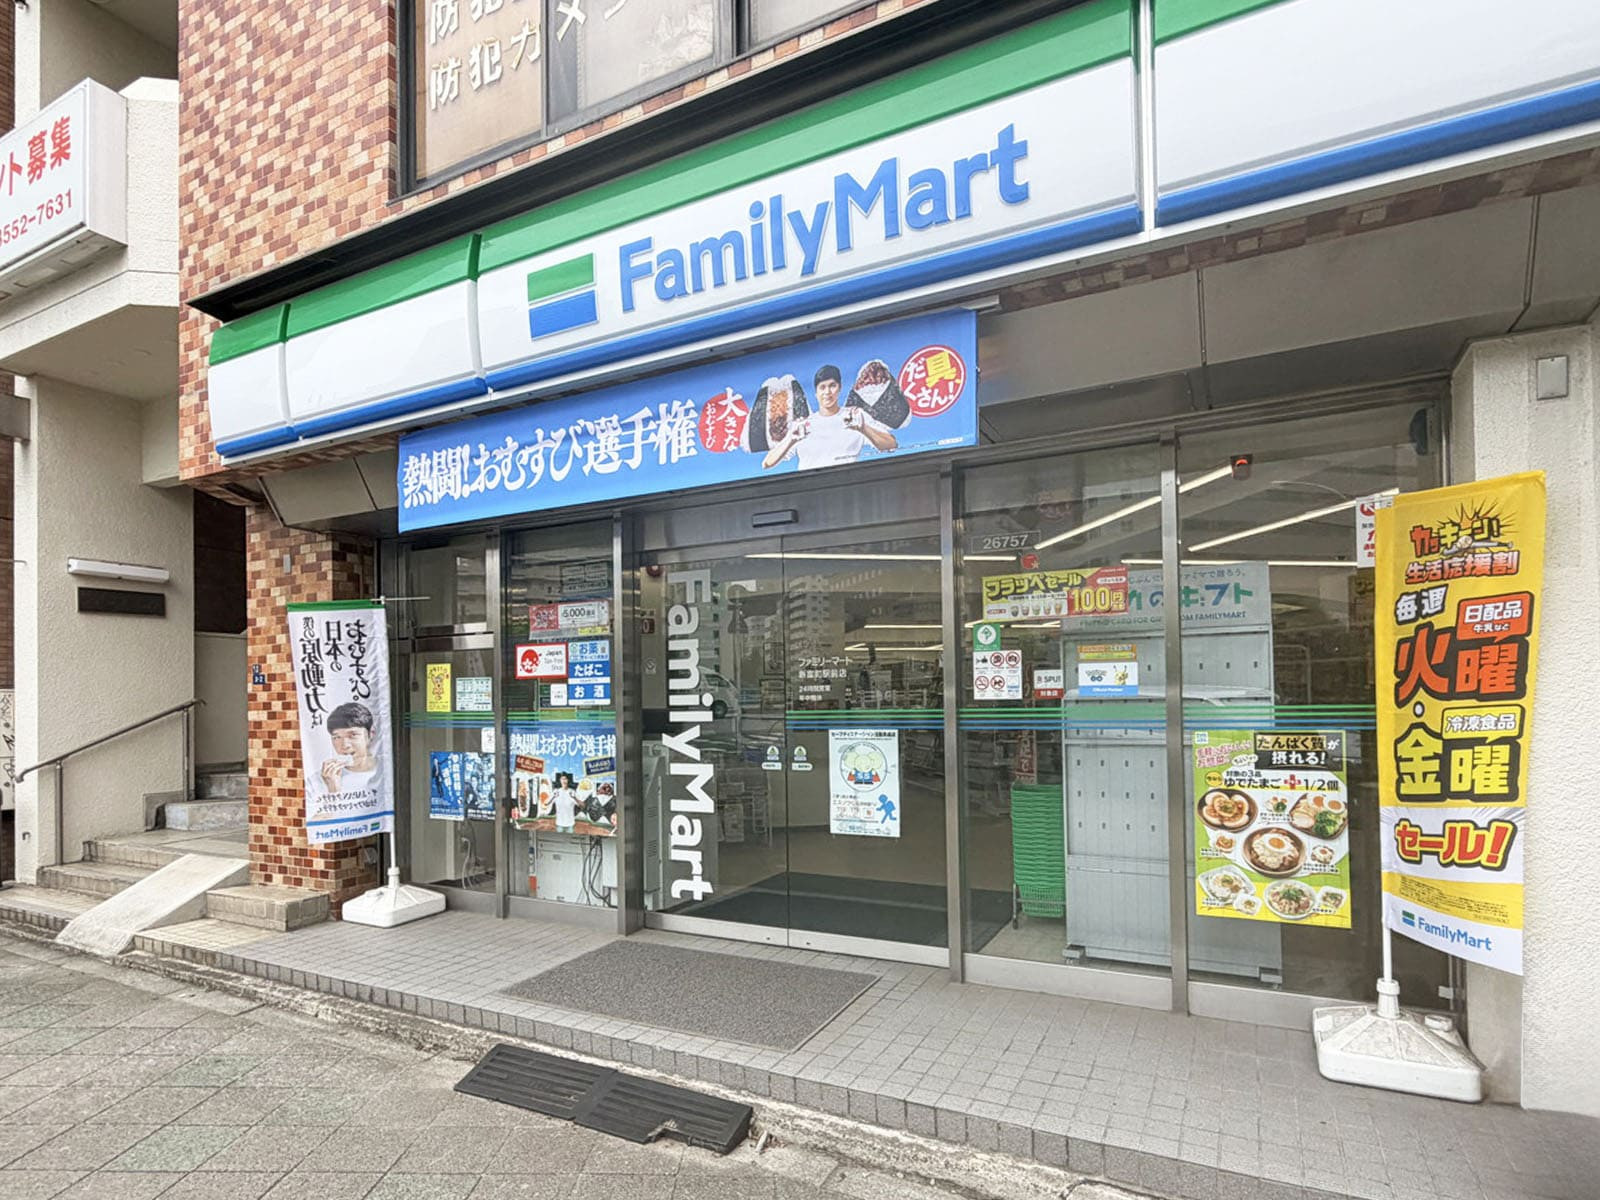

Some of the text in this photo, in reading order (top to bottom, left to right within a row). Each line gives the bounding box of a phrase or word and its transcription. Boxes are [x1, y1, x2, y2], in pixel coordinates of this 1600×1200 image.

[619, 123, 1030, 313] FamilyMart
[705, 403, 718, 448] おむすび
[983, 534, 1028, 550] 26757
[1404, 550, 1520, 584] 生活応援割
[1396, 586, 1447, 622] 毎週
[1464, 600, 1523, 624] 日配品
[574, 664, 604, 677] たばこ
[798, 656, 854, 667] ファミリーマート
[1397, 628, 1519, 701] 火曜
[662, 568, 715, 901] FamilyMart
[1445, 713, 1517, 732] 冷凍食品
[1397, 728, 1511, 795] 金曜
[1224, 778, 1281, 788] ゆでたまご
[1396, 821, 1514, 868] セール!
[1418, 917, 1492, 951] FamilyMart
